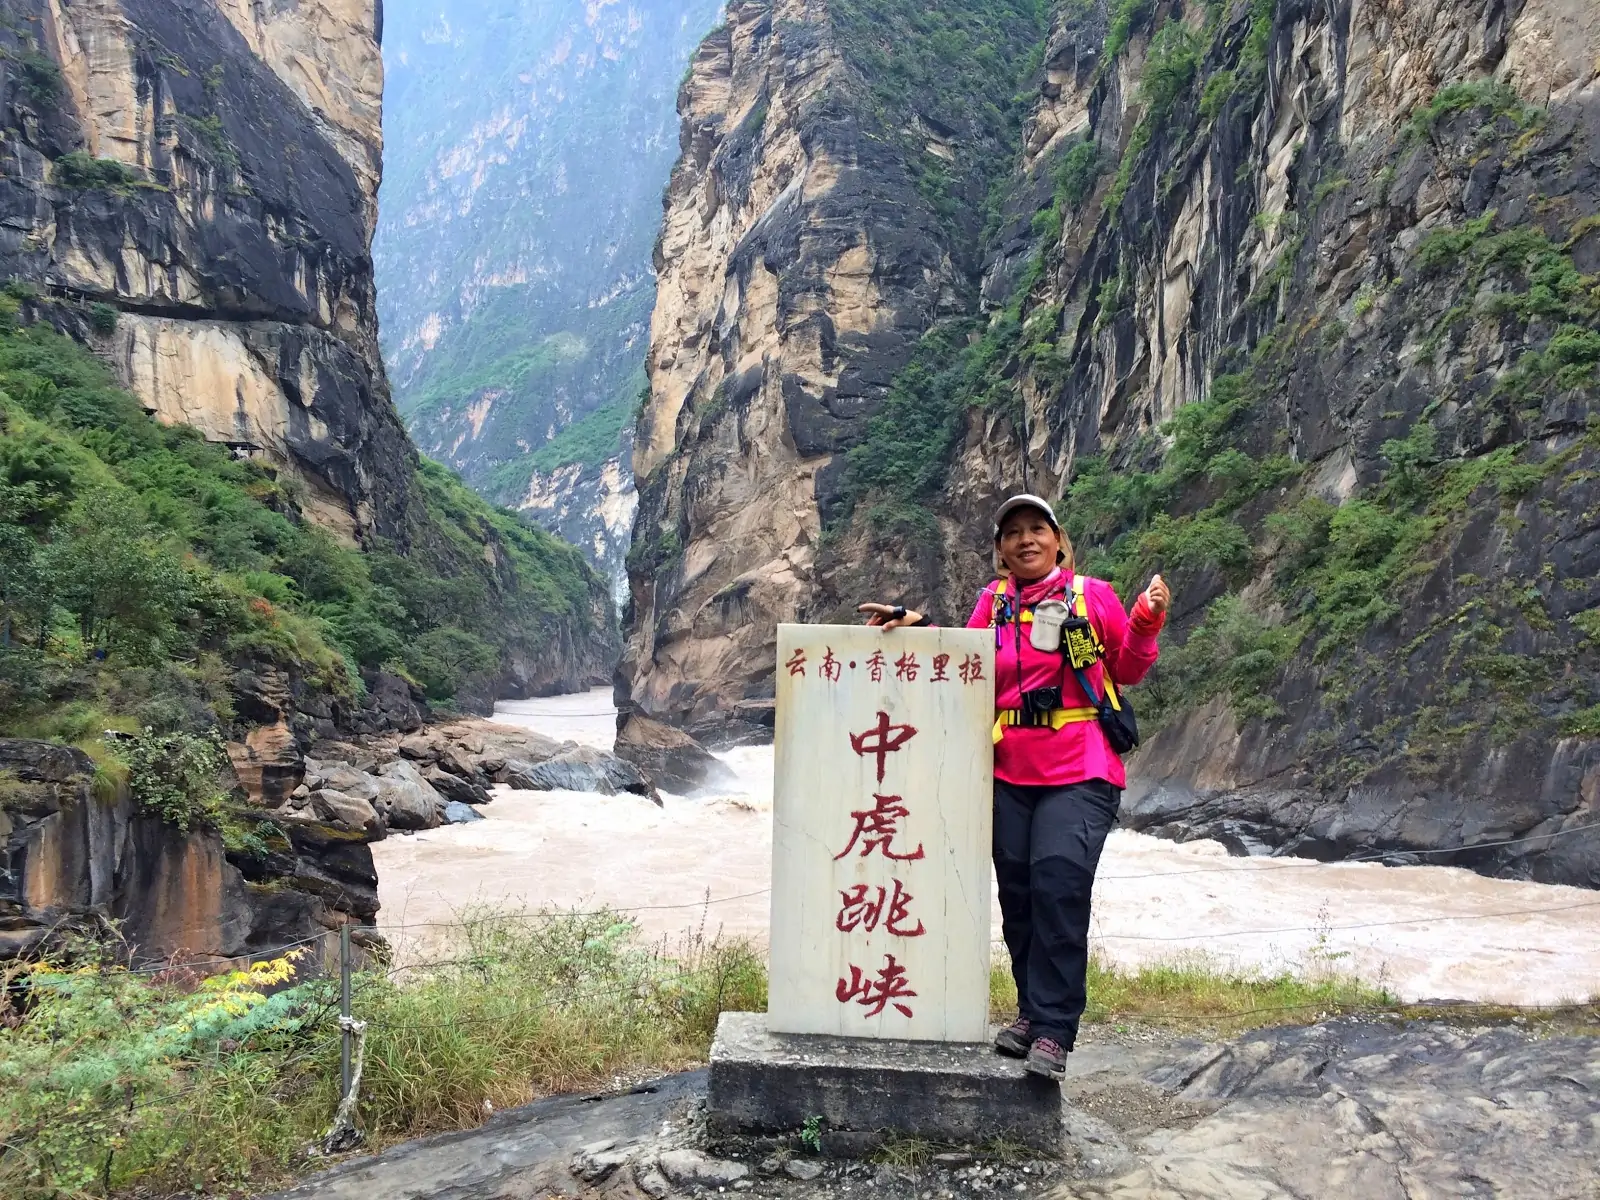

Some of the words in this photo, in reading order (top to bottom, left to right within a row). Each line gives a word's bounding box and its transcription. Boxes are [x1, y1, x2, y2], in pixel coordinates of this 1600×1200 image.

[1075, 628, 1087, 655] NORTH
[833, 710, 927, 1019] 中虎跳峡
